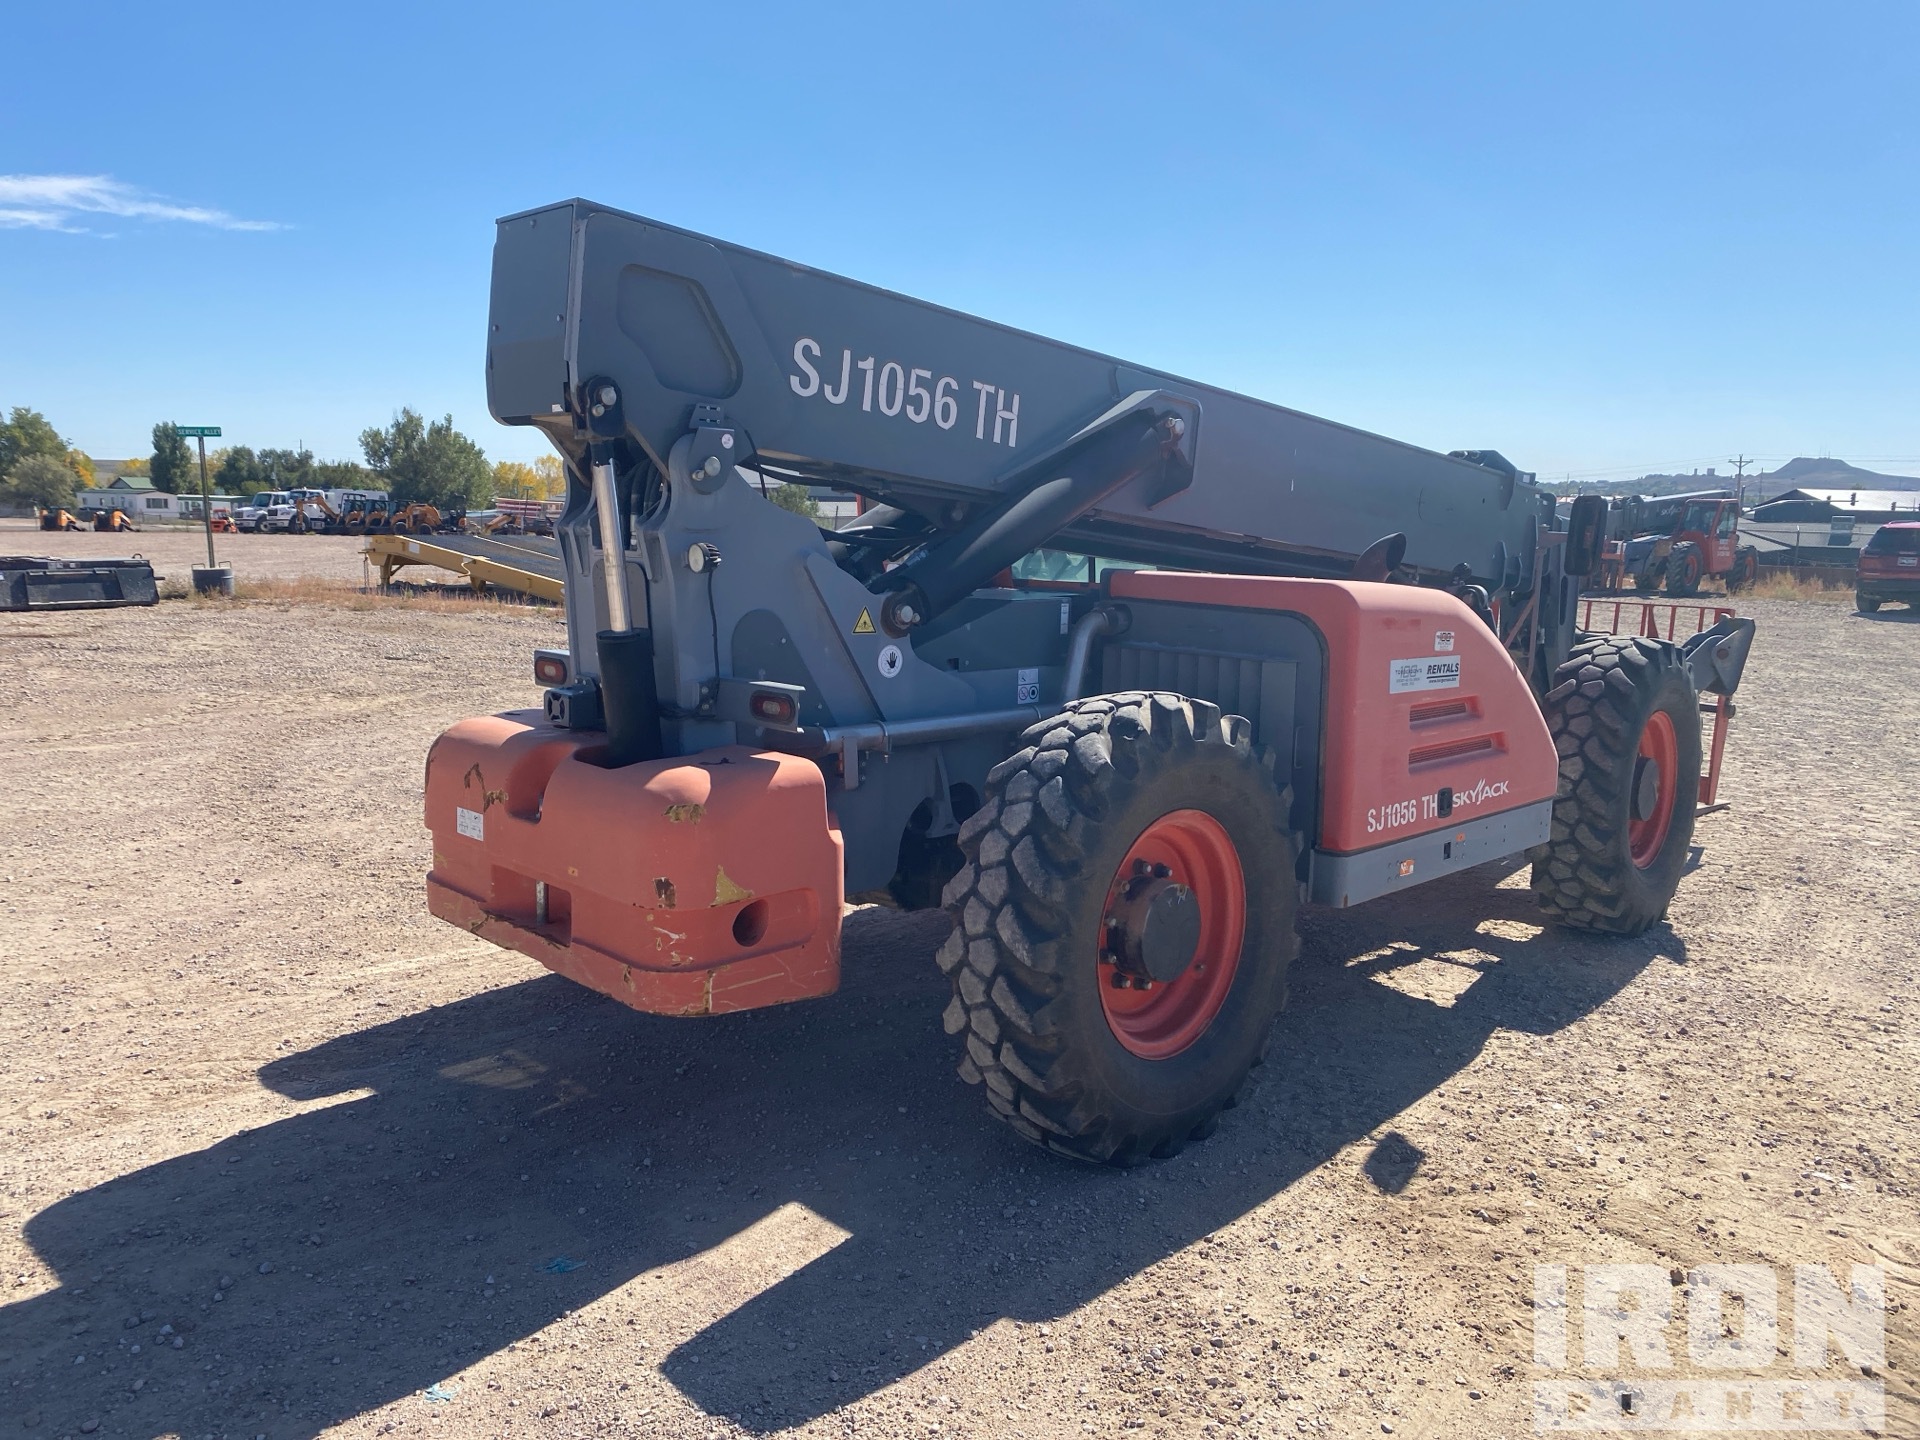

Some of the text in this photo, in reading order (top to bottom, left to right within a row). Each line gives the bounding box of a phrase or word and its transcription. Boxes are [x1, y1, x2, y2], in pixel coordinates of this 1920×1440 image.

[790, 338, 1020, 448] SJ1056 TH
[1426, 662, 1460, 675] RENTALS
[1452, 778, 1510, 808] SKYJACK
[1367, 793, 1439, 833] SJ1056 TH
